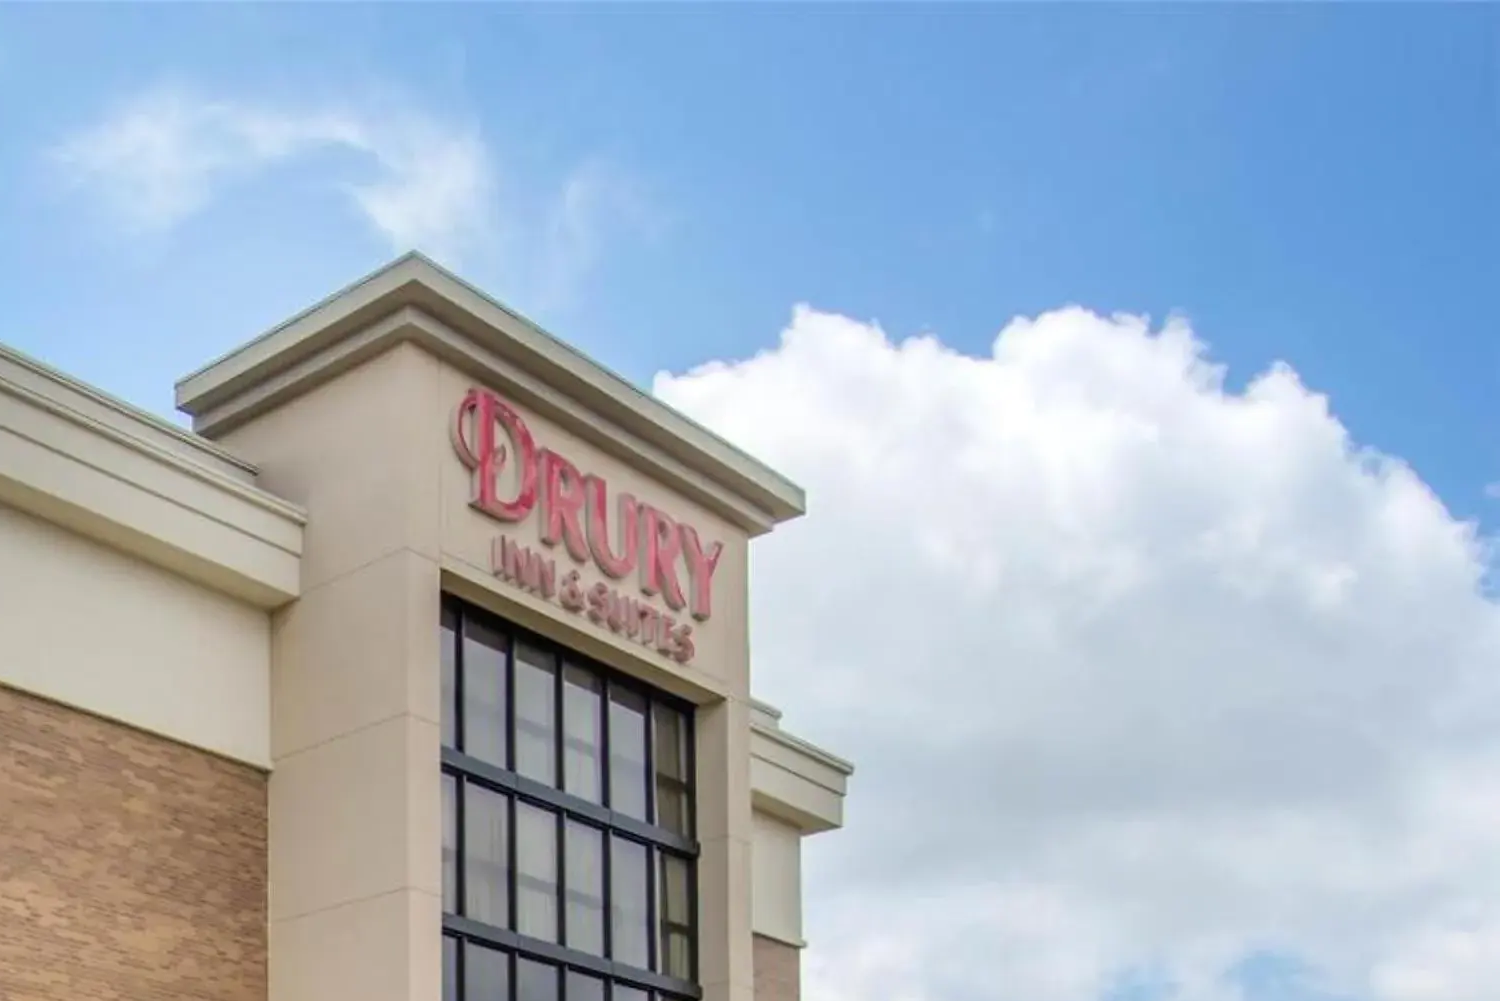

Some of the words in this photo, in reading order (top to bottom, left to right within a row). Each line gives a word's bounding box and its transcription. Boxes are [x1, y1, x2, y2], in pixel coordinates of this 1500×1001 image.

[451, 388, 724, 622] DRURY
[490, 534, 556, 600] INN
[560, 570, 584, 613] &
[587, 582, 695, 663] SUITES
